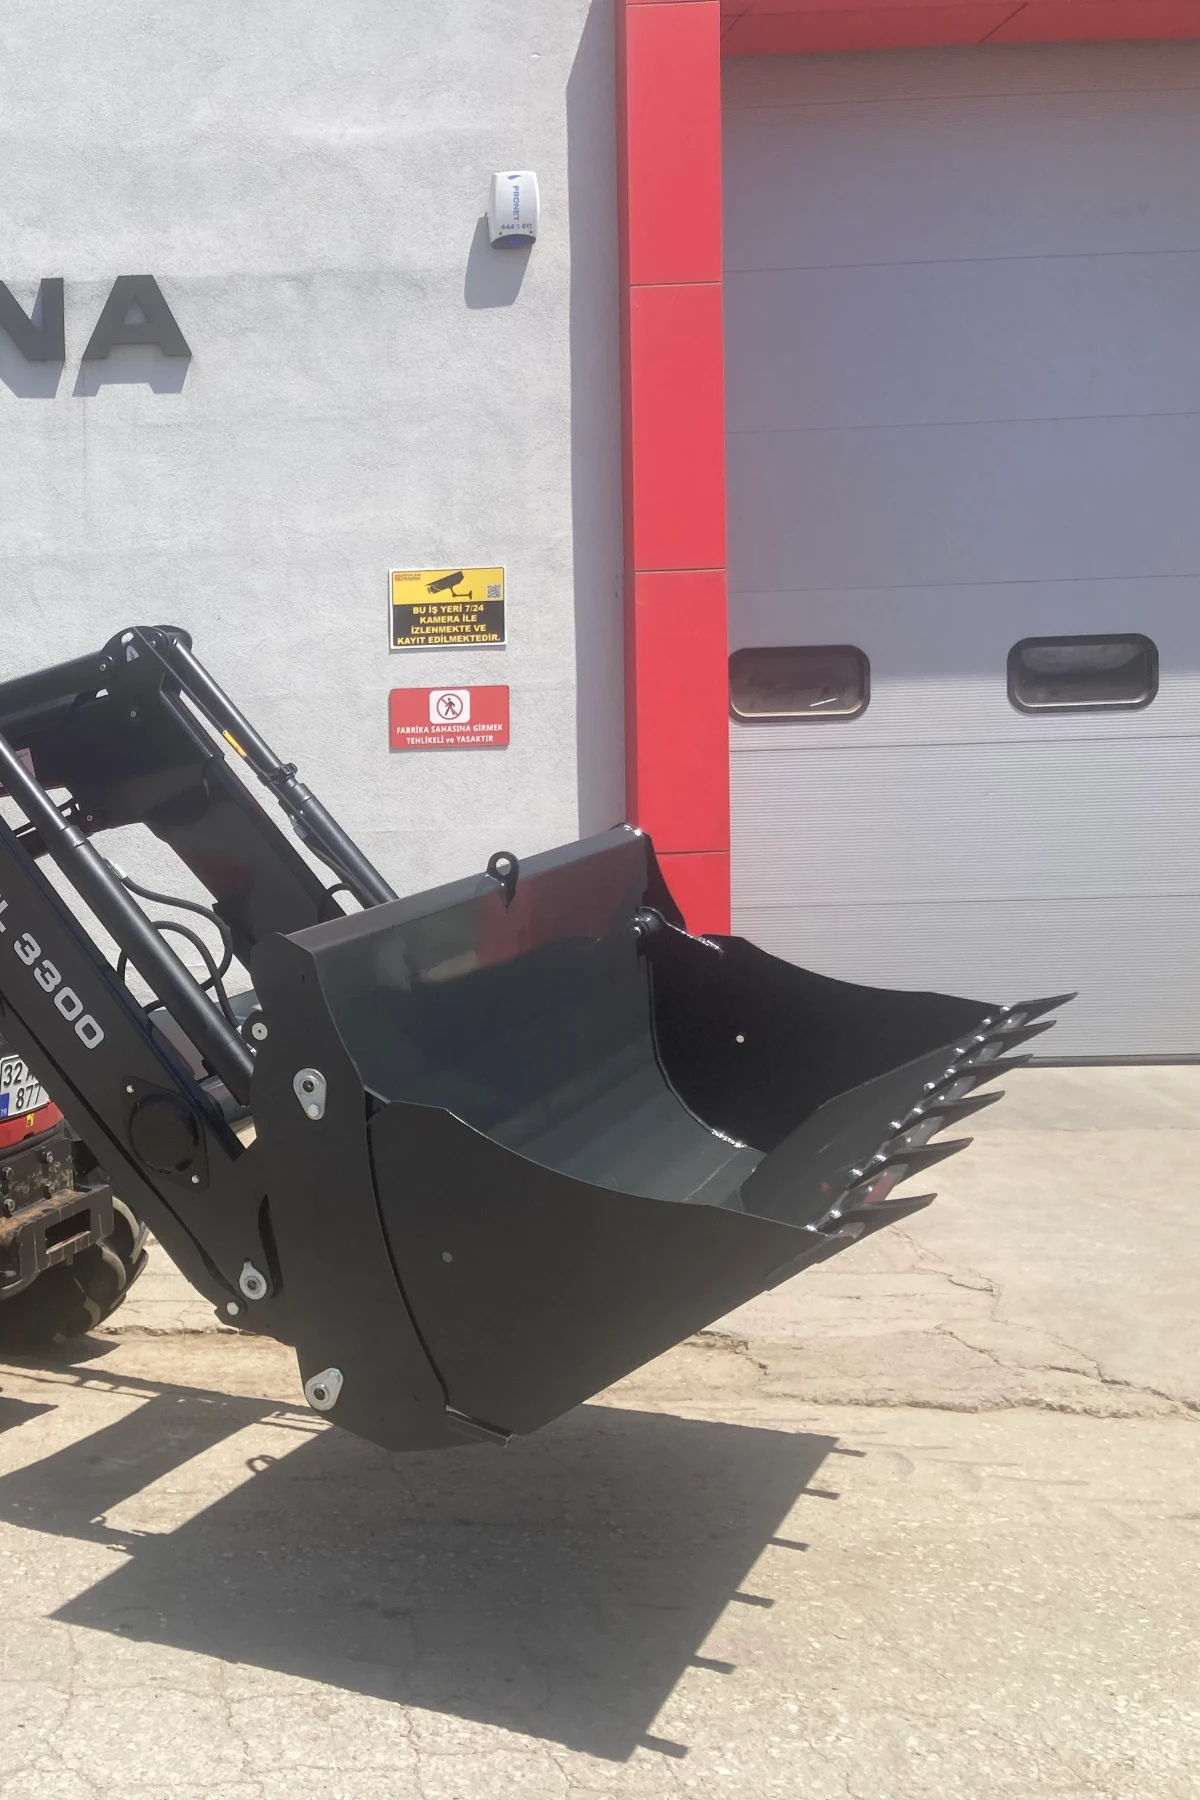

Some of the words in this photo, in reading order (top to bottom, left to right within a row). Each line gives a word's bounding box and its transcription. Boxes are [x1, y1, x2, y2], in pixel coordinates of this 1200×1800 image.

[428, 605, 438, 614] İŞ
[441, 604, 462, 613] YERİ
[465, 604, 484, 612] 7/24
[420, 616, 460, 624] KAMERA
[463, 614, 477, 622] İLE
[411, 625, 471, 634] İZLENMEKTE
[474, 624, 487, 632] VE
[397, 637, 426, 645] KAYIT
[428, 633, 501, 643] EDİLMEKTEDİR.
[397, 725, 429, 734] FABRİKA
[431, 724, 471, 733] SAHASINA
[473, 723, 503, 732] GİRMEK
[406, 735, 444, 744] TEHLİKELİ
[456, 735, 494, 743] YASAKTIR
[13, 932, 105, 1050] 3300
[3, 1062, 23, 1088] 32
